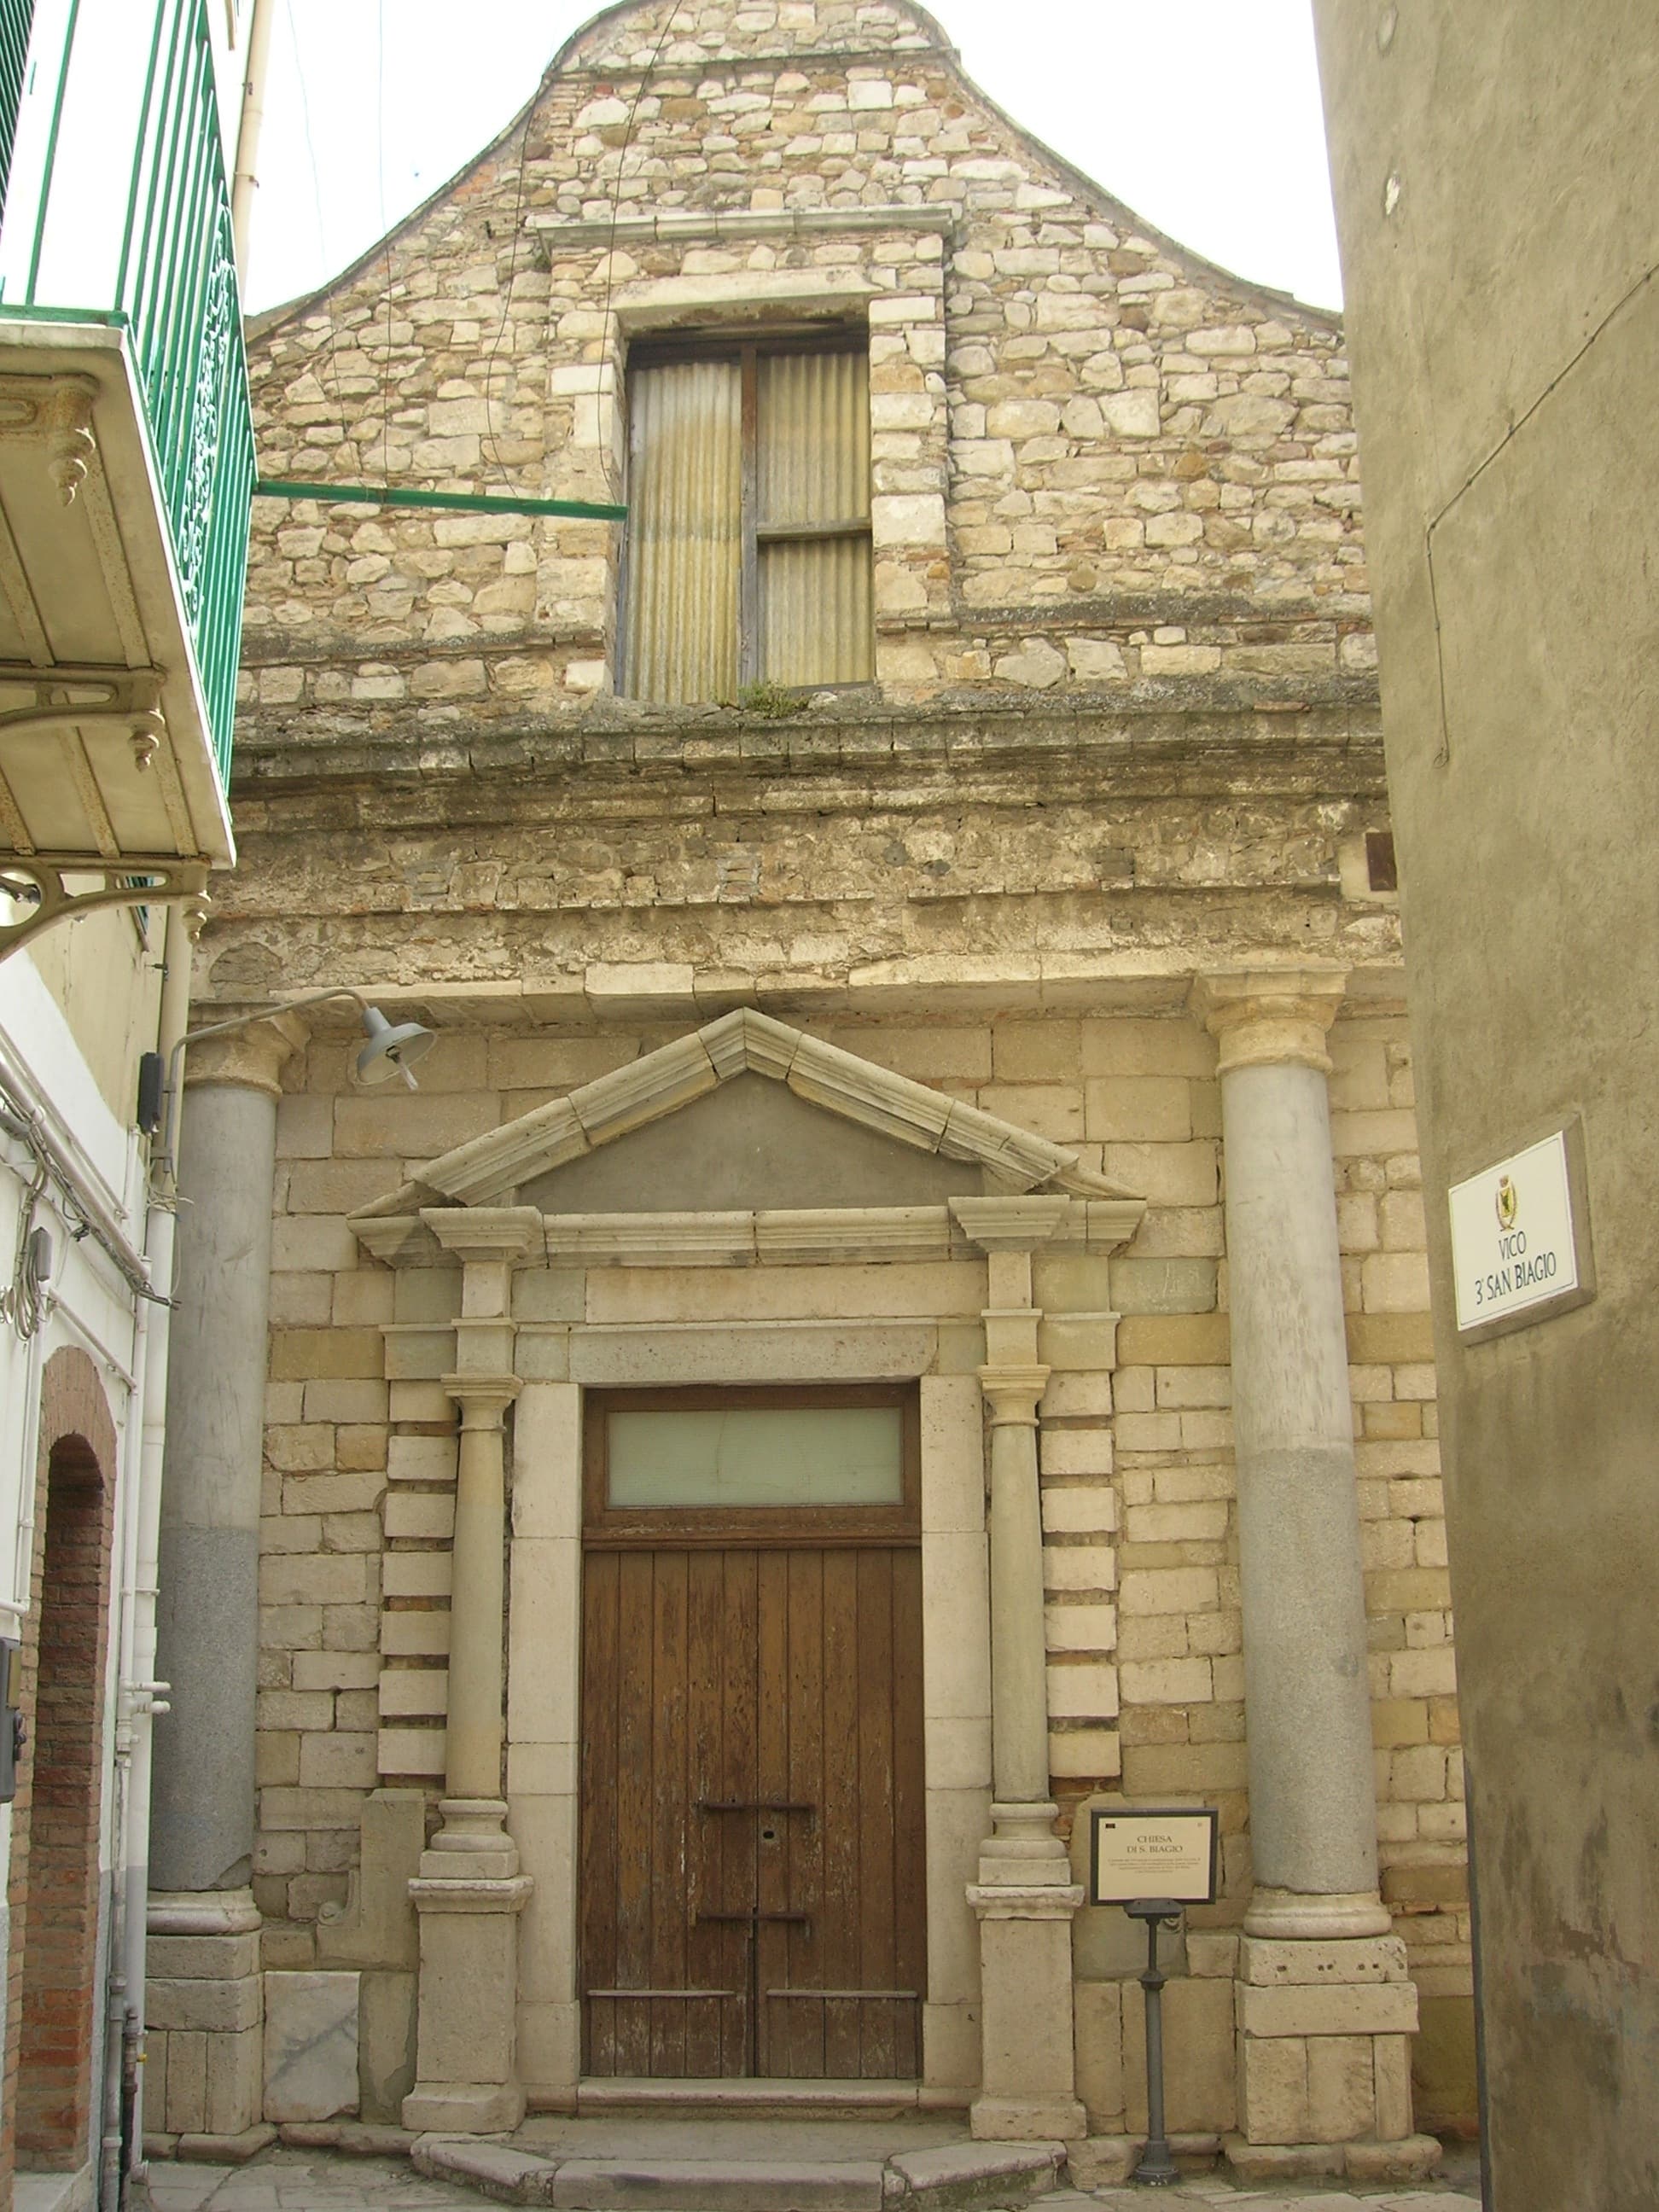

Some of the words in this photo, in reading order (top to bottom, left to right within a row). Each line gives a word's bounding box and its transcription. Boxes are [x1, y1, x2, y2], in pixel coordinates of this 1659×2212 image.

[1499, 1231, 1527, 1260] VICO
[1487, 1267, 1512, 1301] SAN
[1514, 1251, 1557, 1289] BIAGIO
[1137, 1835, 1173, 1843] CHIESA
[1126, 1845, 1138, 1854] DI
[1150, 1845, 1184, 1854] BIAGIO
